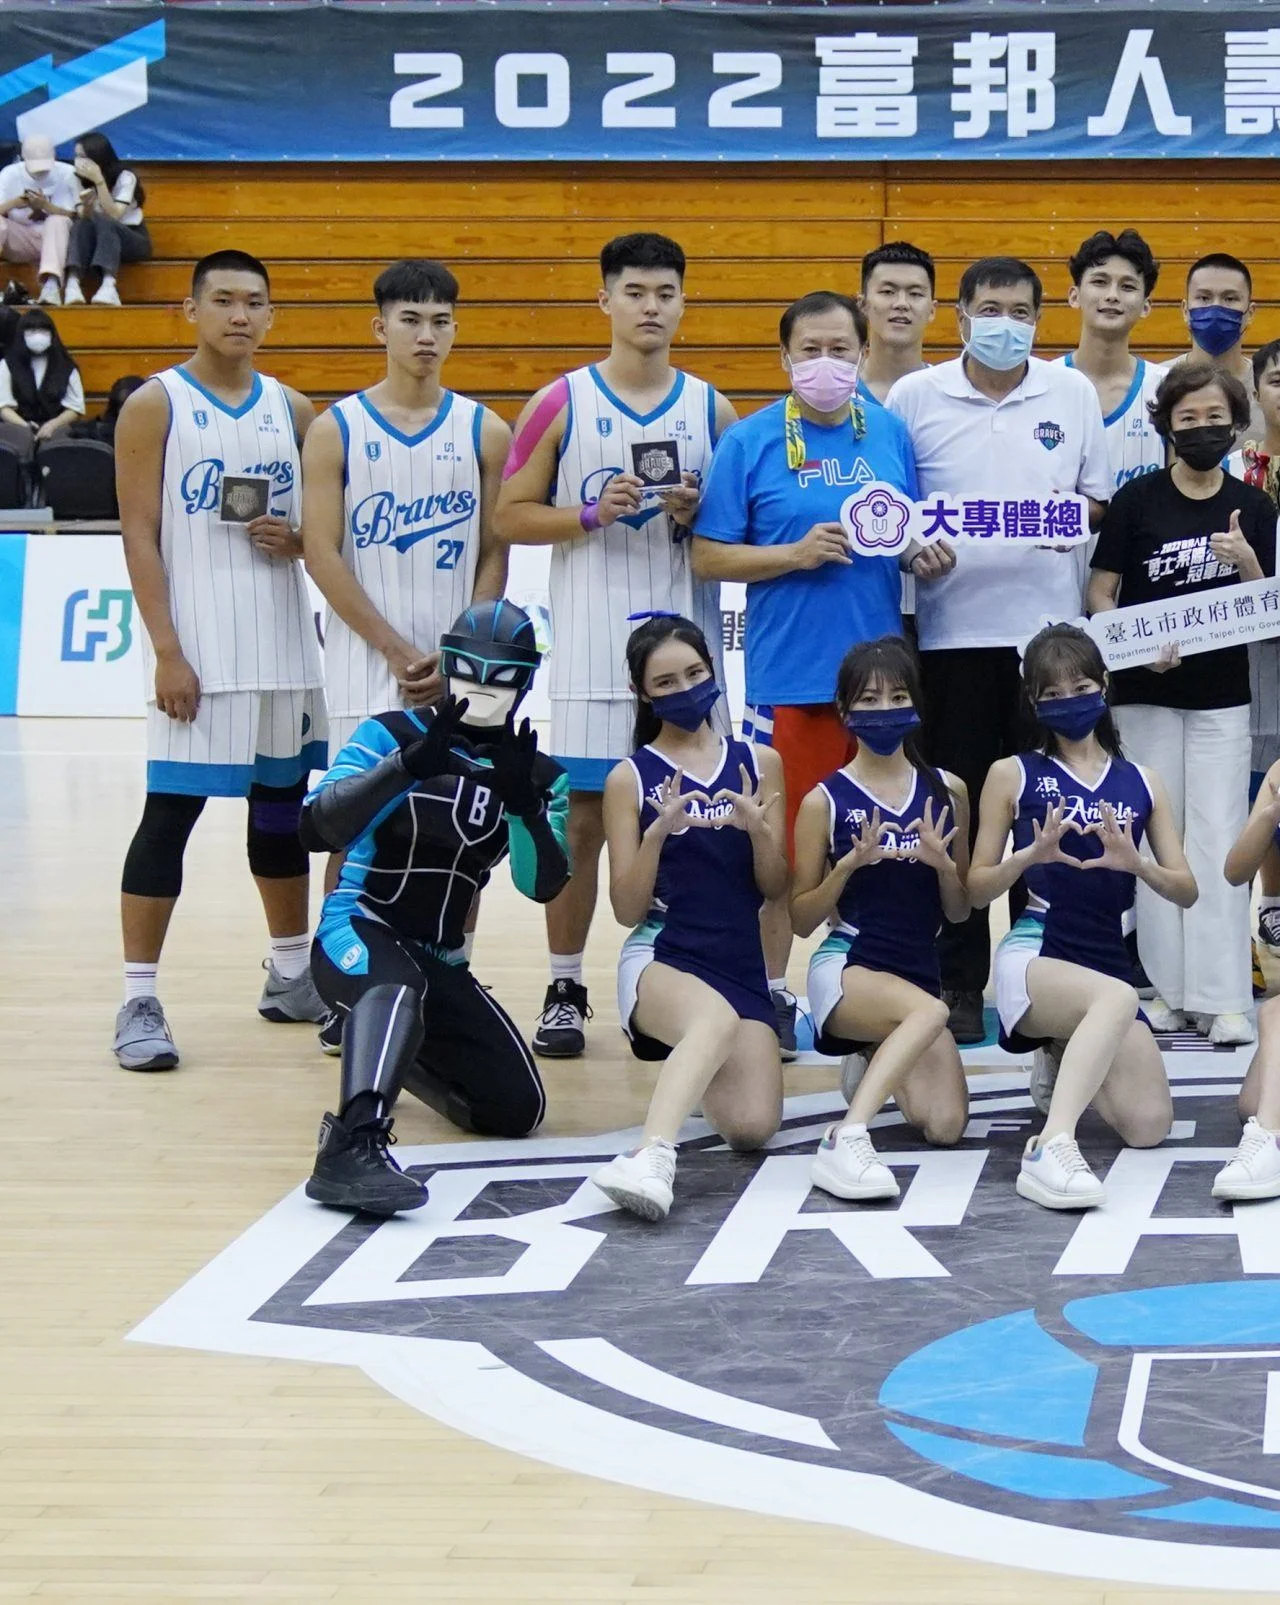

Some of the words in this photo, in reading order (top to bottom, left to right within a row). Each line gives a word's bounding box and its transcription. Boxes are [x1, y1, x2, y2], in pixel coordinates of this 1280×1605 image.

[798, 456, 875, 488] FILA
[352, 490, 477, 550] Braves
[922, 499, 1083, 538] 大專體總
[436, 540, 464, 570] 27
[1109, 644, 1160, 662] Department
[1209, 629, 1236, 641] Taipei
[1238, 622, 1256, 635] City
[468, 786, 491, 827] B
